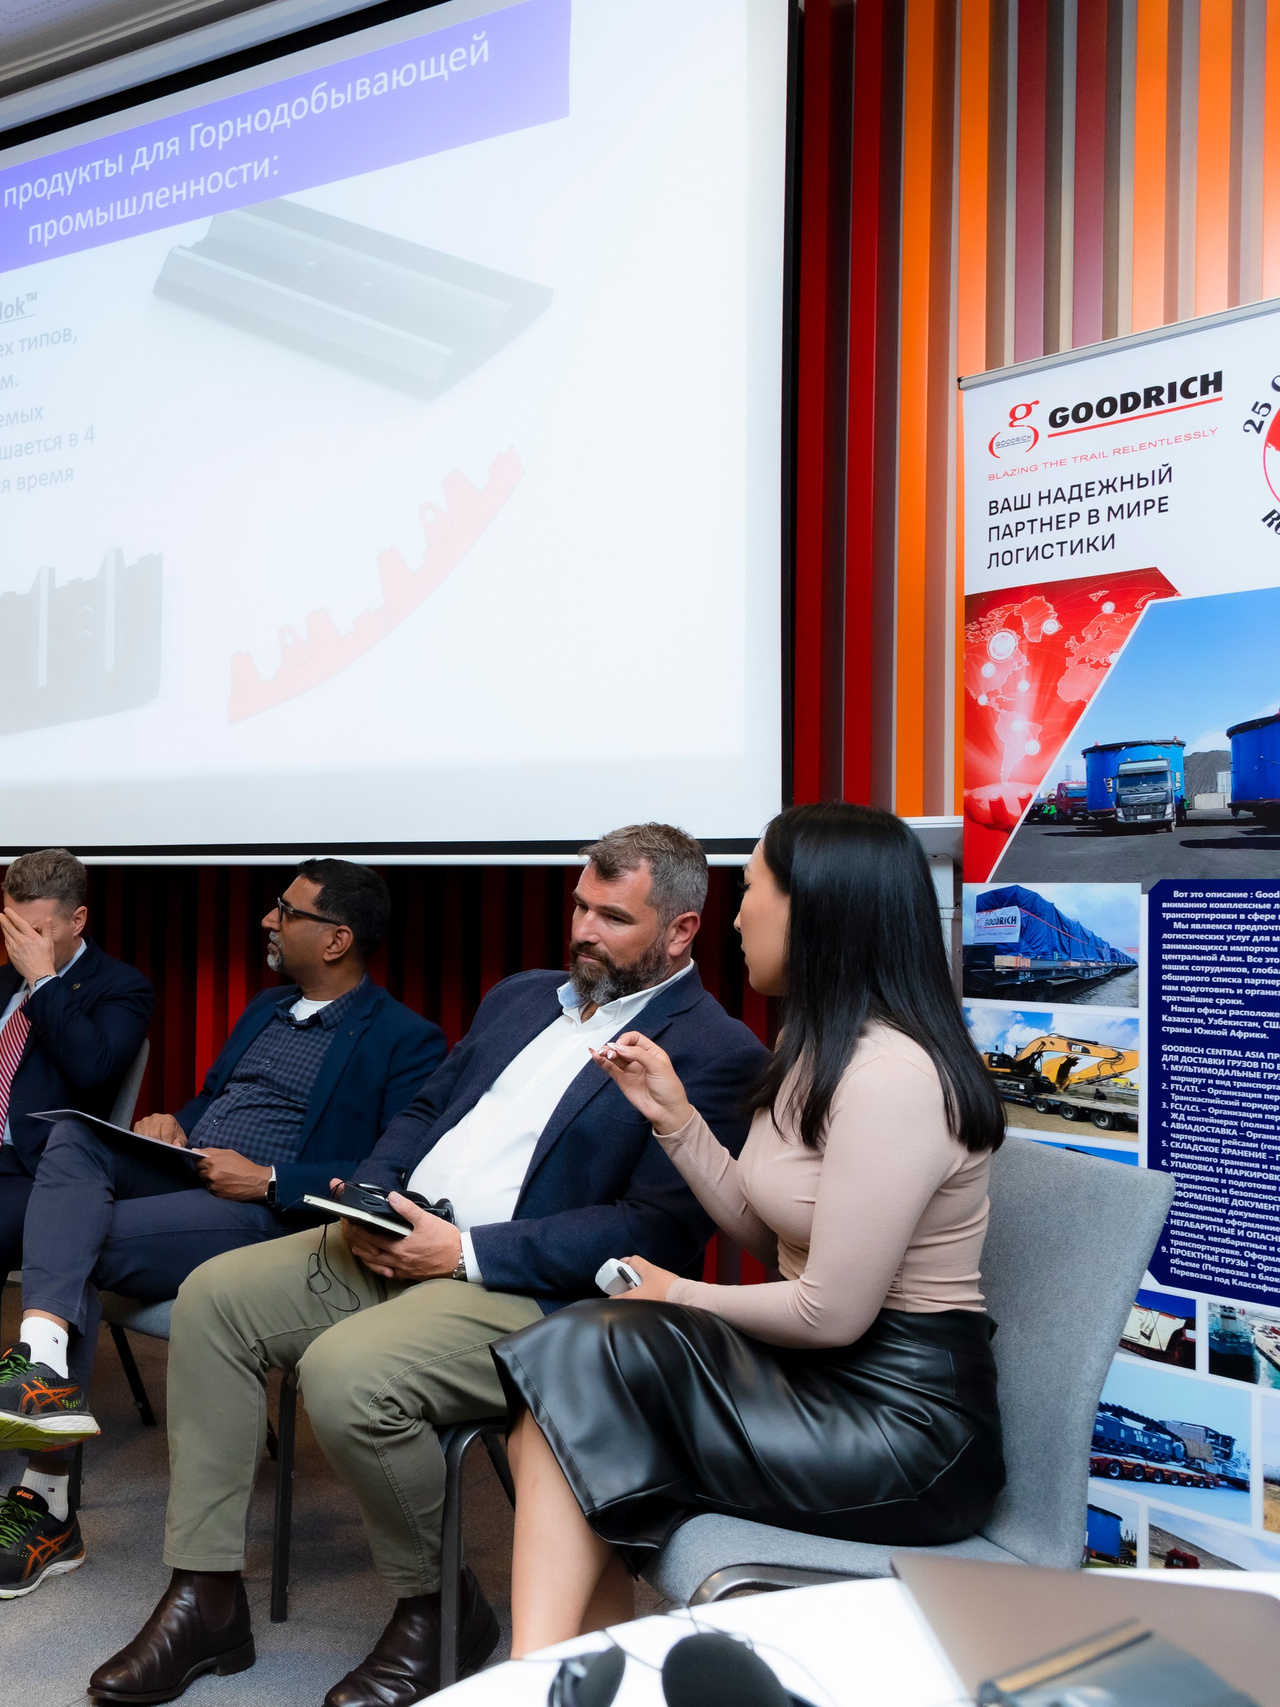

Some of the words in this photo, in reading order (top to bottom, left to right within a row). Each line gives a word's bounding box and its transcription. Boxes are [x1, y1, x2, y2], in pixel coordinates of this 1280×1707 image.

[4, 154, 124, 209] продукты
[130, 136, 179, 174] для
[189, 30, 489, 151] Горнодобывающей
[28, 154, 279, 247] промышленности:
[18, 327, 78, 352] типов,
[1049, 370, 1223, 428] GOODRICH
[1242, 401, 1272, 434] 25
[68, 433, 78, 447] в
[83, 424, 95, 444] 4
[989, 464, 1038, 481] BLAZING
[1042, 458, 1067, 469] THE
[1071, 451, 1109, 464] TRAIL
[1113, 427, 1218, 456] RELENTLESSLY
[16, 467, 74, 493] время
[989, 490, 1031, 516] ВАШ
[1038, 462, 1173, 507] НАДЕЖНЫЙ
[989, 511, 1081, 542] ПАРТНЕР
[1088, 508, 1099, 525] В
[1107, 496, 1169, 522] МИРЕ
[987, 534, 1115, 569] ЛОГИСТИКИ
[1247, 913, 1275, 921] сфере
[1162, 944, 1228, 952] занимающихся
[1162, 954, 1217, 962] центральной
[1247, 955, 1263, 963] Все
[1191, 965, 1249, 974] сотрудников,
[1162, 973, 1210, 983] обширного
[1180, 986, 1234, 994] подготовить
[1162, 995, 1213, 1003] кратчайшие
[1197, 1006, 1226, 1015] офисы
[1162, 1015, 1205, 1025] Казахстан,
[1208, 1017, 1261, 1028] Узбекистан,
[1162, 1026, 1192, 1034] страны
[1194, 1027, 1227, 1036] Южной
[1230, 1030, 1269, 1039] Африки.
[1162, 1044, 1204, 1054] GOODRICH
[1206, 1048, 1242, 1057] CENTRAL
[1245, 1051, 1265, 1059] ASIA
[1162, 1054, 1178, 1062] ДЛЯ
[1180, 1056, 1224, 1065] ДОСТАВКИ
[1227, 1059, 1258, 1068] ГРУЗОВ
[1171, 1064, 1261, 1078] МУЛЬТИМОДАЛЬНЫЕ
[1171, 1076, 1206, 1085] маршрут
[1171, 1084, 1199, 1092] FTL/LTL
[1207, 1088, 1262, 1098] Организация
[1171, 1093, 1239, 1107] Транскаспийский
[1171, 1103, 1200, 1112] FCL/LCL
[1208, 1107, 1262, 1118] Организация
[1171, 1122, 1237, 1136] АВИАДОСТАВКА
[1170, 1141, 1219, 1153] СКЛАДСКОЕ
[1221, 1148, 1267, 1159] ХРАНЕНИЕ
[1171, 1152, 1218, 1163] временного
[1170, 1161, 1214, 1172] УПАКОВКА
[1171, 1219, 1235, 1235] НЕГАБАРИТНЫЕ
[1170, 1247, 1219, 1262] ПРОЕКТНЫЕ
[1221, 1256, 1248, 1267] ГРУЗЫ
[1170, 1258, 1200, 1268] объеме
[1171, 1267, 1212, 1280] Перевозка
[1214, 1276, 1230, 1285] под
